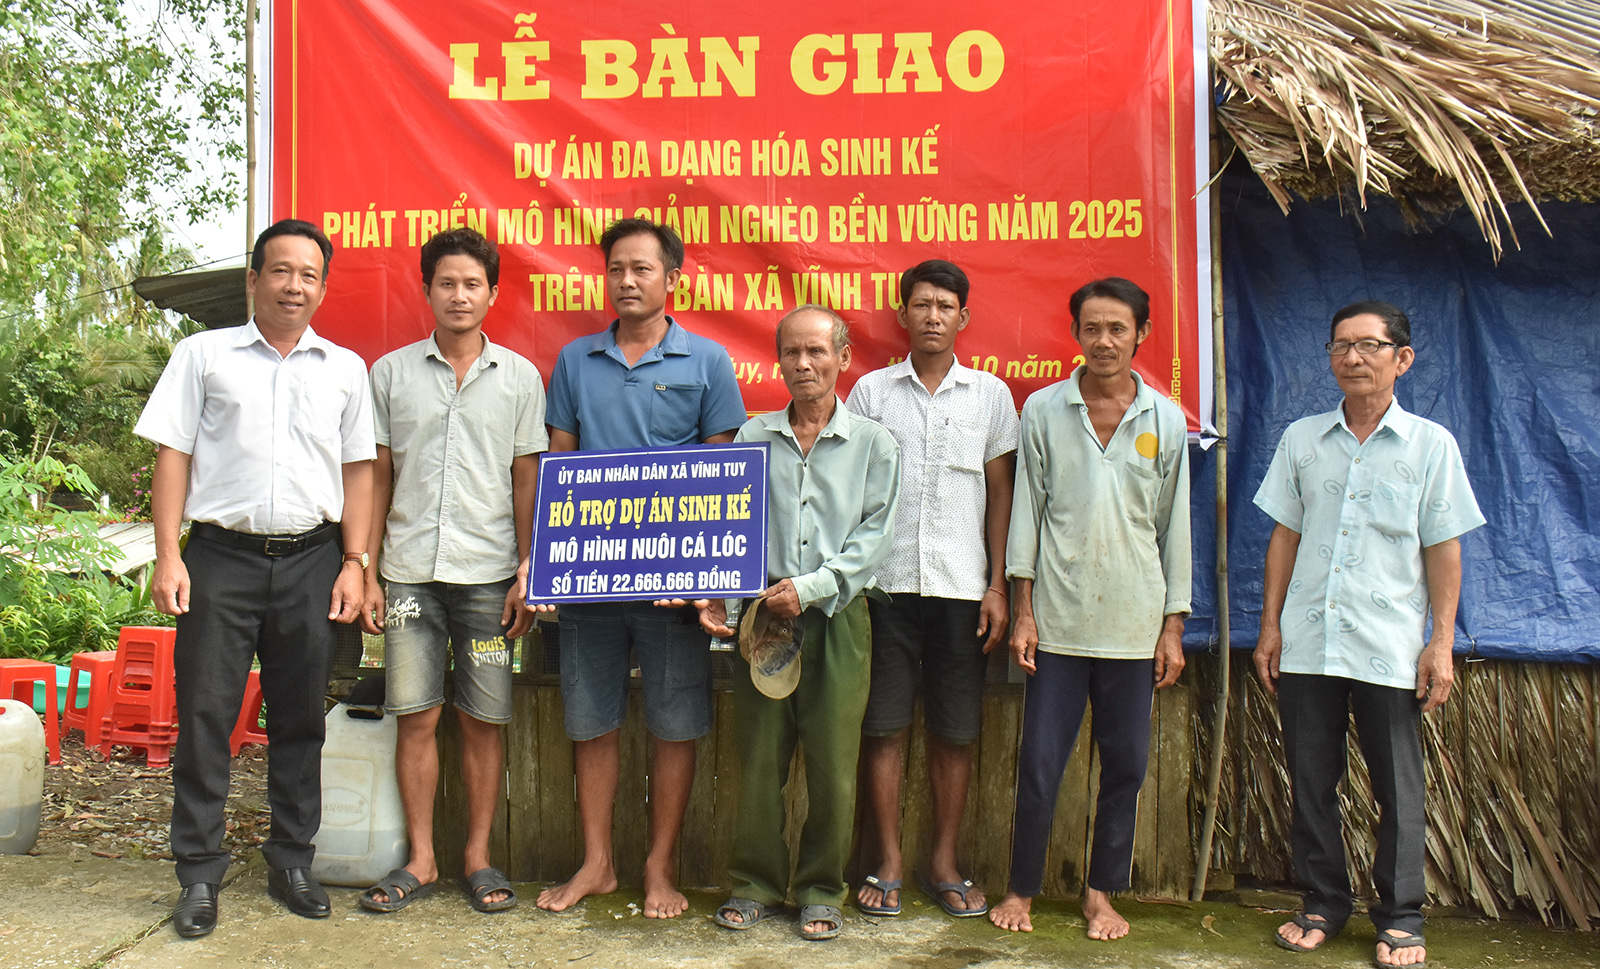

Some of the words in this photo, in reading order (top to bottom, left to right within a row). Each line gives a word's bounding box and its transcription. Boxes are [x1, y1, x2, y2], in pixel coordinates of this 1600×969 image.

[448, 12, 551, 101] LỄ
[580, 23, 760, 100] BÀN
[790, 29, 1006, 96] GIAO
[513, 139, 557, 188] DỰ
[561, 134, 603, 180] ÁN
[611, 140, 652, 179] ĐA
[660, 138, 742, 185] DẠNG
[751, 131, 812, 177] HÓA
[820, 137, 892, 177] SINH
[901, 123, 941, 175] KẾ
[323, 202, 397, 249] PHÁT
[497, 199, 544, 246] MÔ
[719, 197, 819, 244] NGHÈO
[828, 192, 888, 243] BỀN
[897, 197, 978, 243] VỮNG
[988, 193, 1059, 241] NĂM
[1068, 198, 1143, 240] 2025
[529, 266, 605, 312] TRÊN
[673, 265, 734, 312] BÀN
[743, 264, 785, 311] XÃ
[791, 264, 862, 311] VĨNH
[870, 272, 904, 311] TU
[731, 357, 763, 385] uy,
[971, 355, 999, 376] 10
[1005, 354, 1062, 379] năm
[558, 466, 574, 485] ỦY
[576, 468, 602, 484] BAN
[604, 464, 639, 482] NHÂN
[641, 462, 668, 480] DÂN
[670, 461, 688, 479] XÃ
[690, 460, 720, 478] VĨNH
[723, 461, 747, 477] TUY
[548, 489, 575, 527] HỖ
[579, 497, 617, 531] TRỢ
[619, 496, 646, 530] DỰ
[648, 490, 674, 523] ÁN
[678, 494, 722, 522] SINH
[726, 483, 752, 520] KẾ
[549, 536, 578, 563] MÔ
[582, 534, 627, 562] HÌNH
[631, 532, 676, 560] NUÔI
[681, 531, 706, 559] CÁ
[711, 530, 747, 557] LÓC
[551, 569, 573, 595] SỐ
[575, 568, 608, 594] TIỀN
[611, 571, 694, 593] 22.666.666
[697, 564, 741, 590] ĐỒNG
